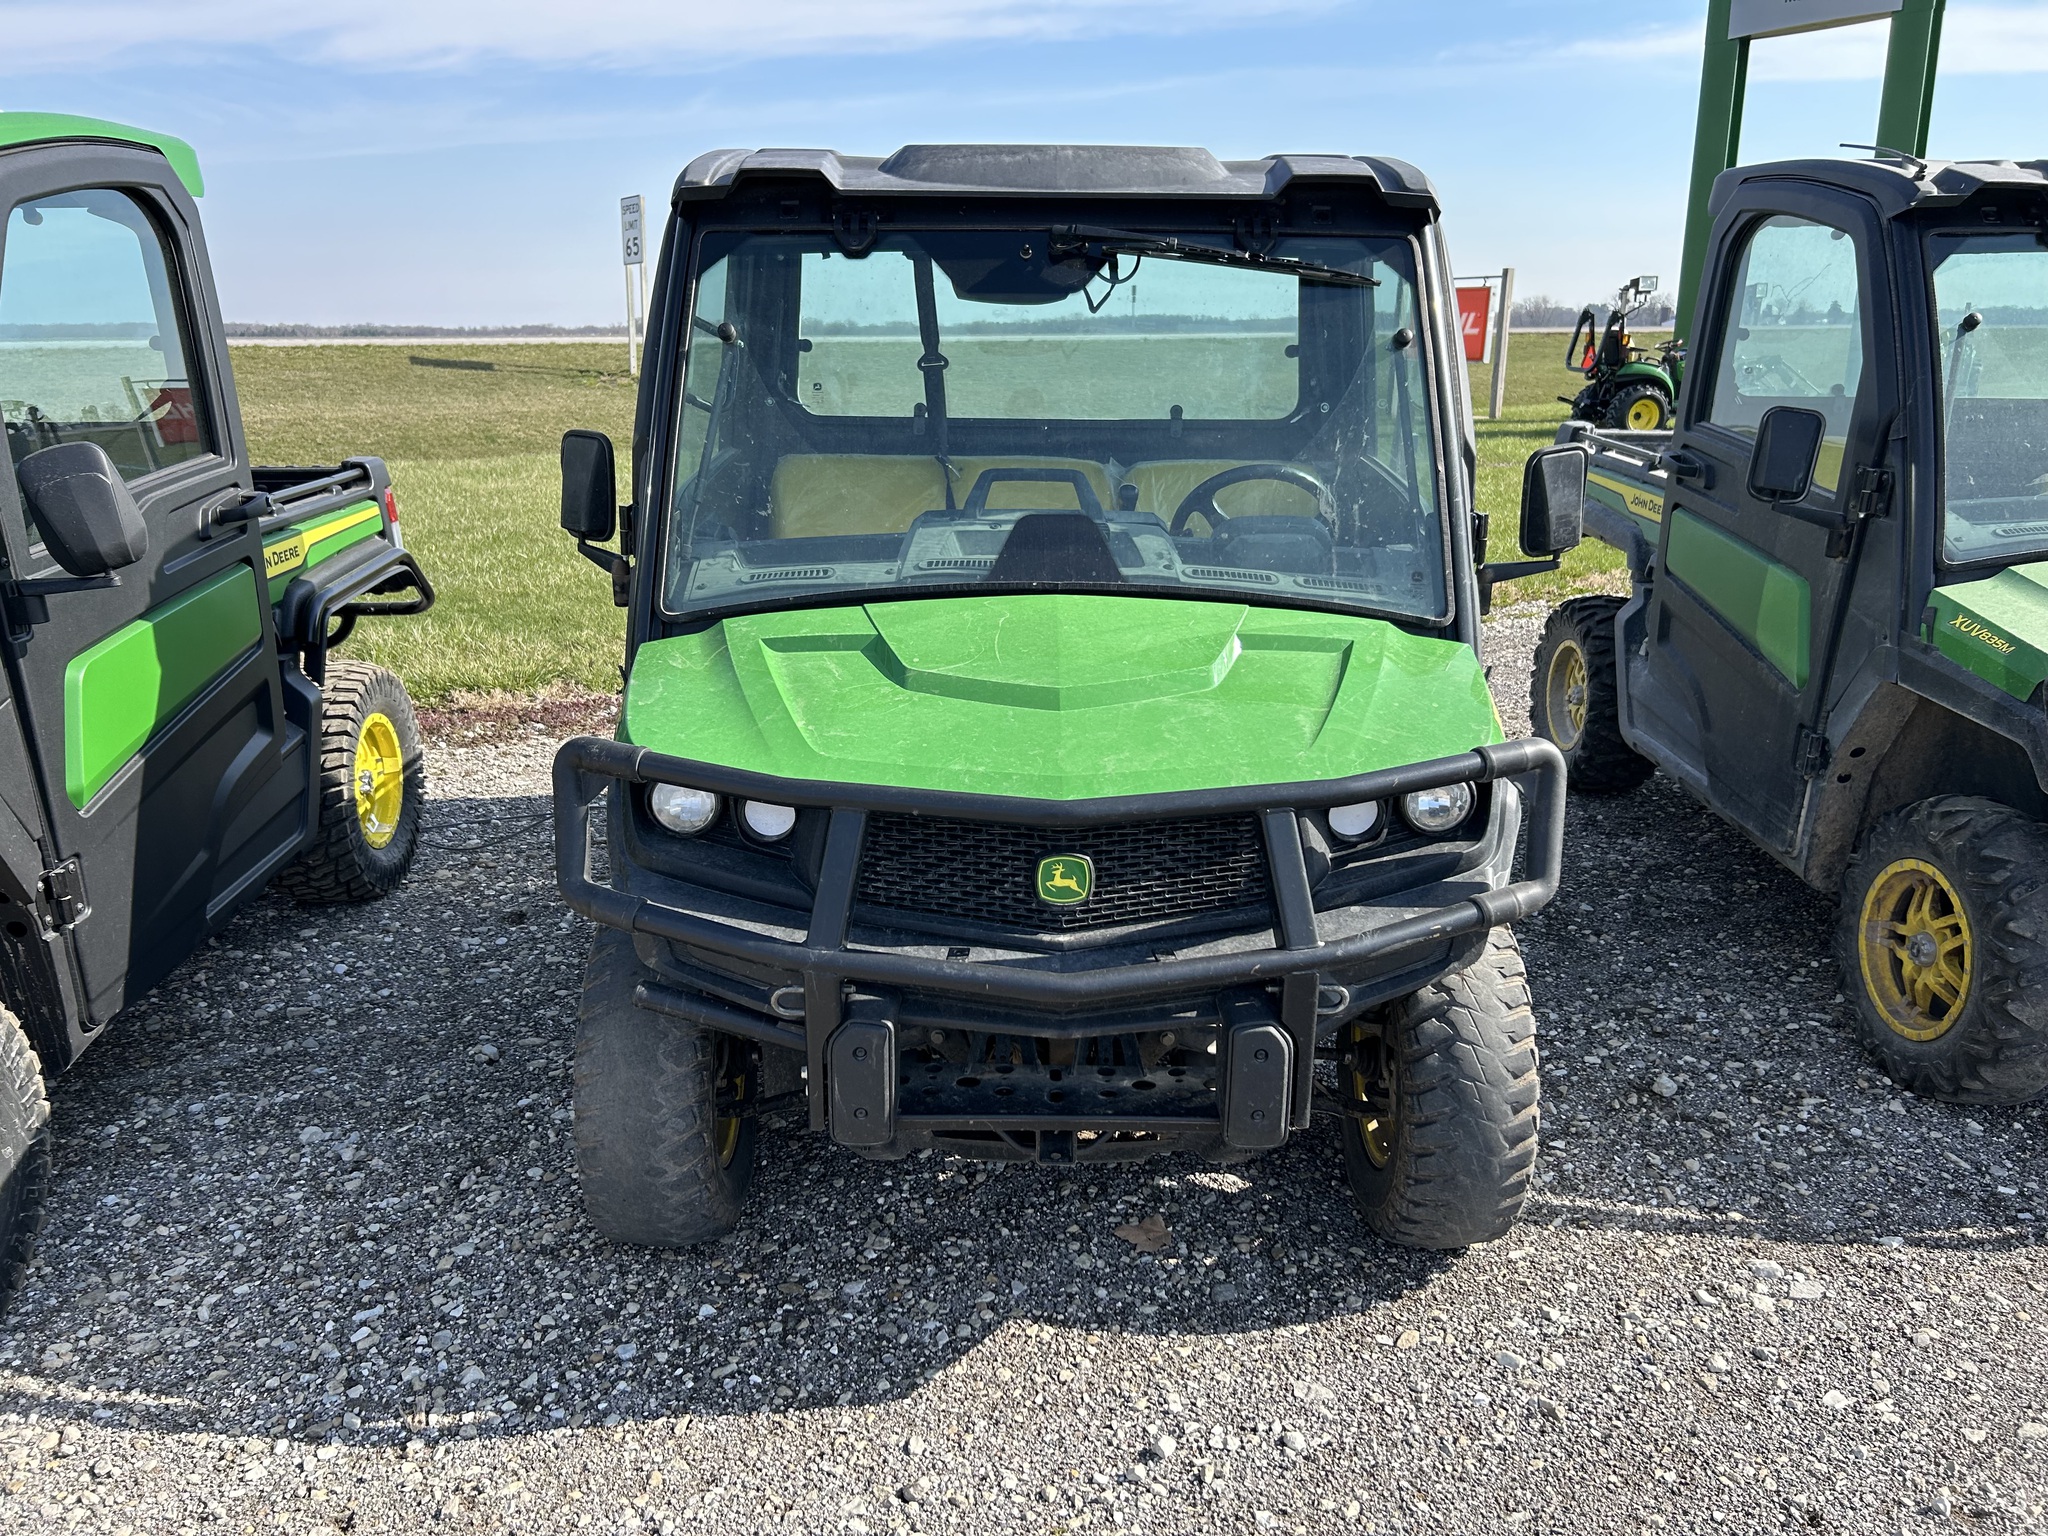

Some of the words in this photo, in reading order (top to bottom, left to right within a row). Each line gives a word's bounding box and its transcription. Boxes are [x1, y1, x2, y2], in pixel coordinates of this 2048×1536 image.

[622, 203, 640, 216] SPEED
[624, 219, 638, 231] LIMIT
[626, 236, 640, 257] 65
[1631, 493, 1649, 510] JOHN
[272, 545, 300, 566] DEERE
[1948, 614, 2017, 655] XUV835M
